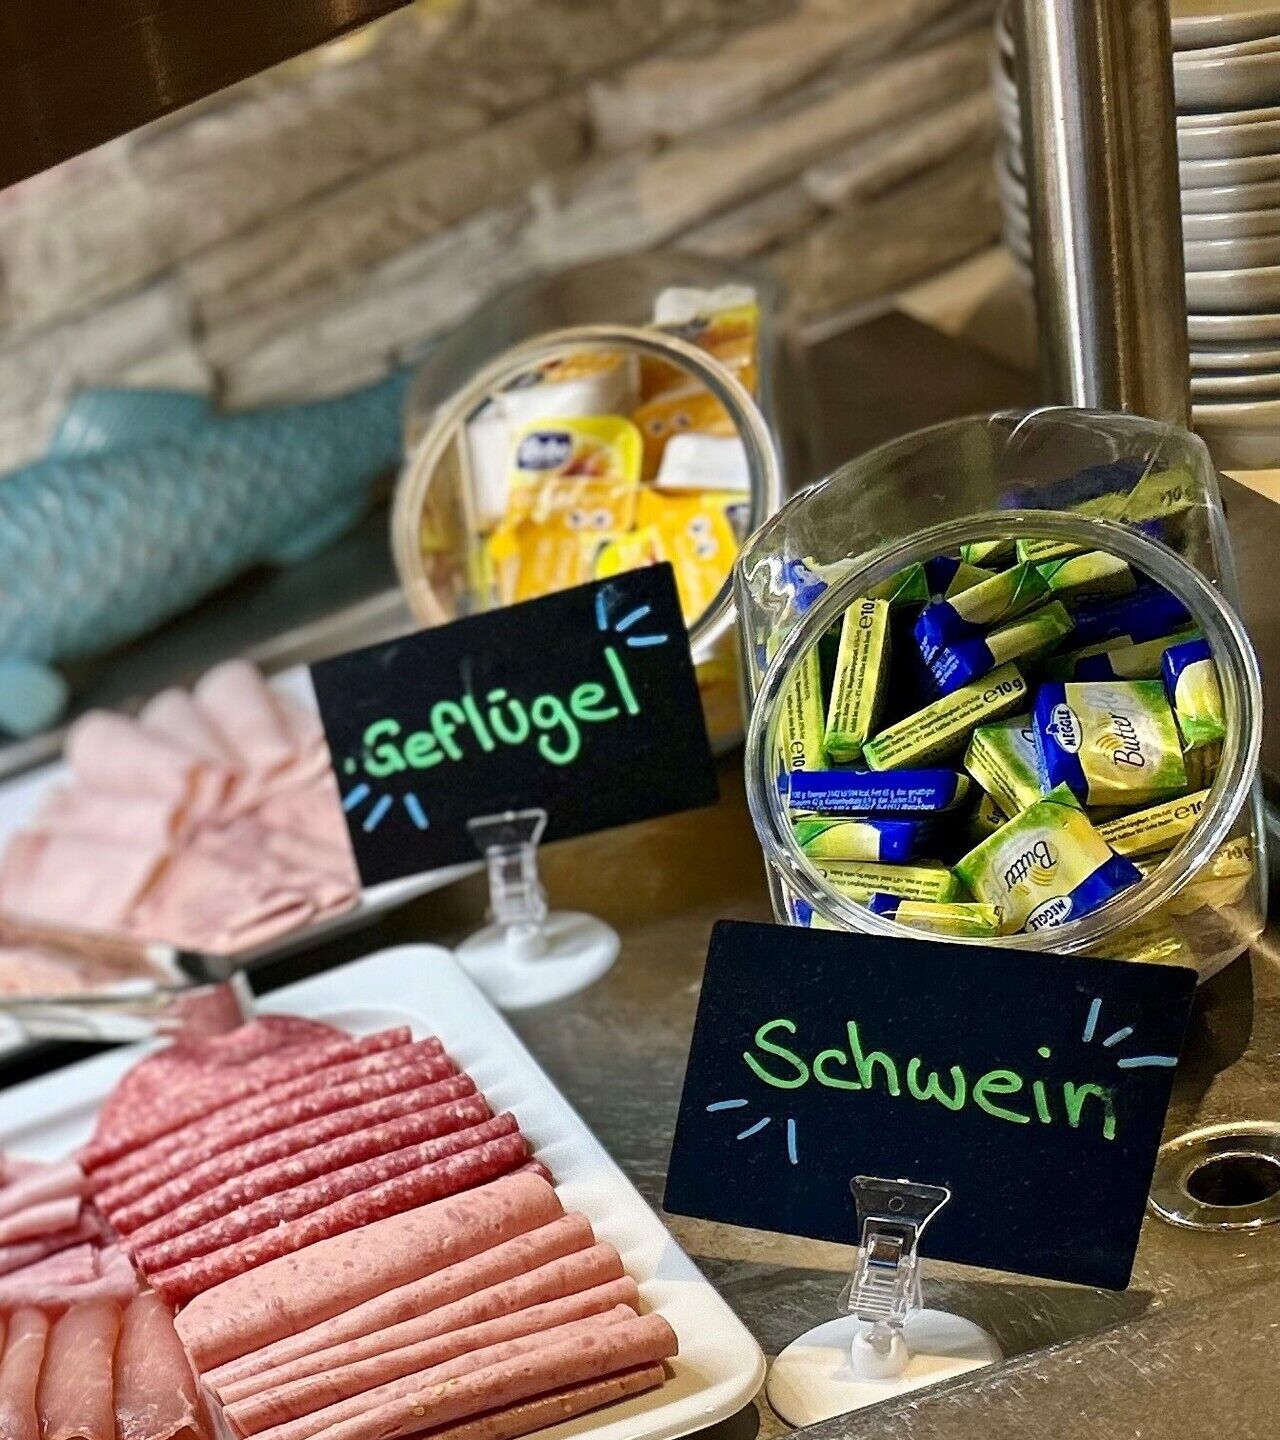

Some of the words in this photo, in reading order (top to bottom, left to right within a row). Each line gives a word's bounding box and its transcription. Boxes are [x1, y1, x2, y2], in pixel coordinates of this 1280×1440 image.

[362, 646, 640, 778] Geflügel
[1062, 709, 1077, 747] MEGGLE
[1112, 711, 1146, 768] Butter
[1003, 840, 1058, 893] Butter
[1029, 899, 1068, 931] MEGGLE
[743, 1018, 1118, 1141] Schwein
